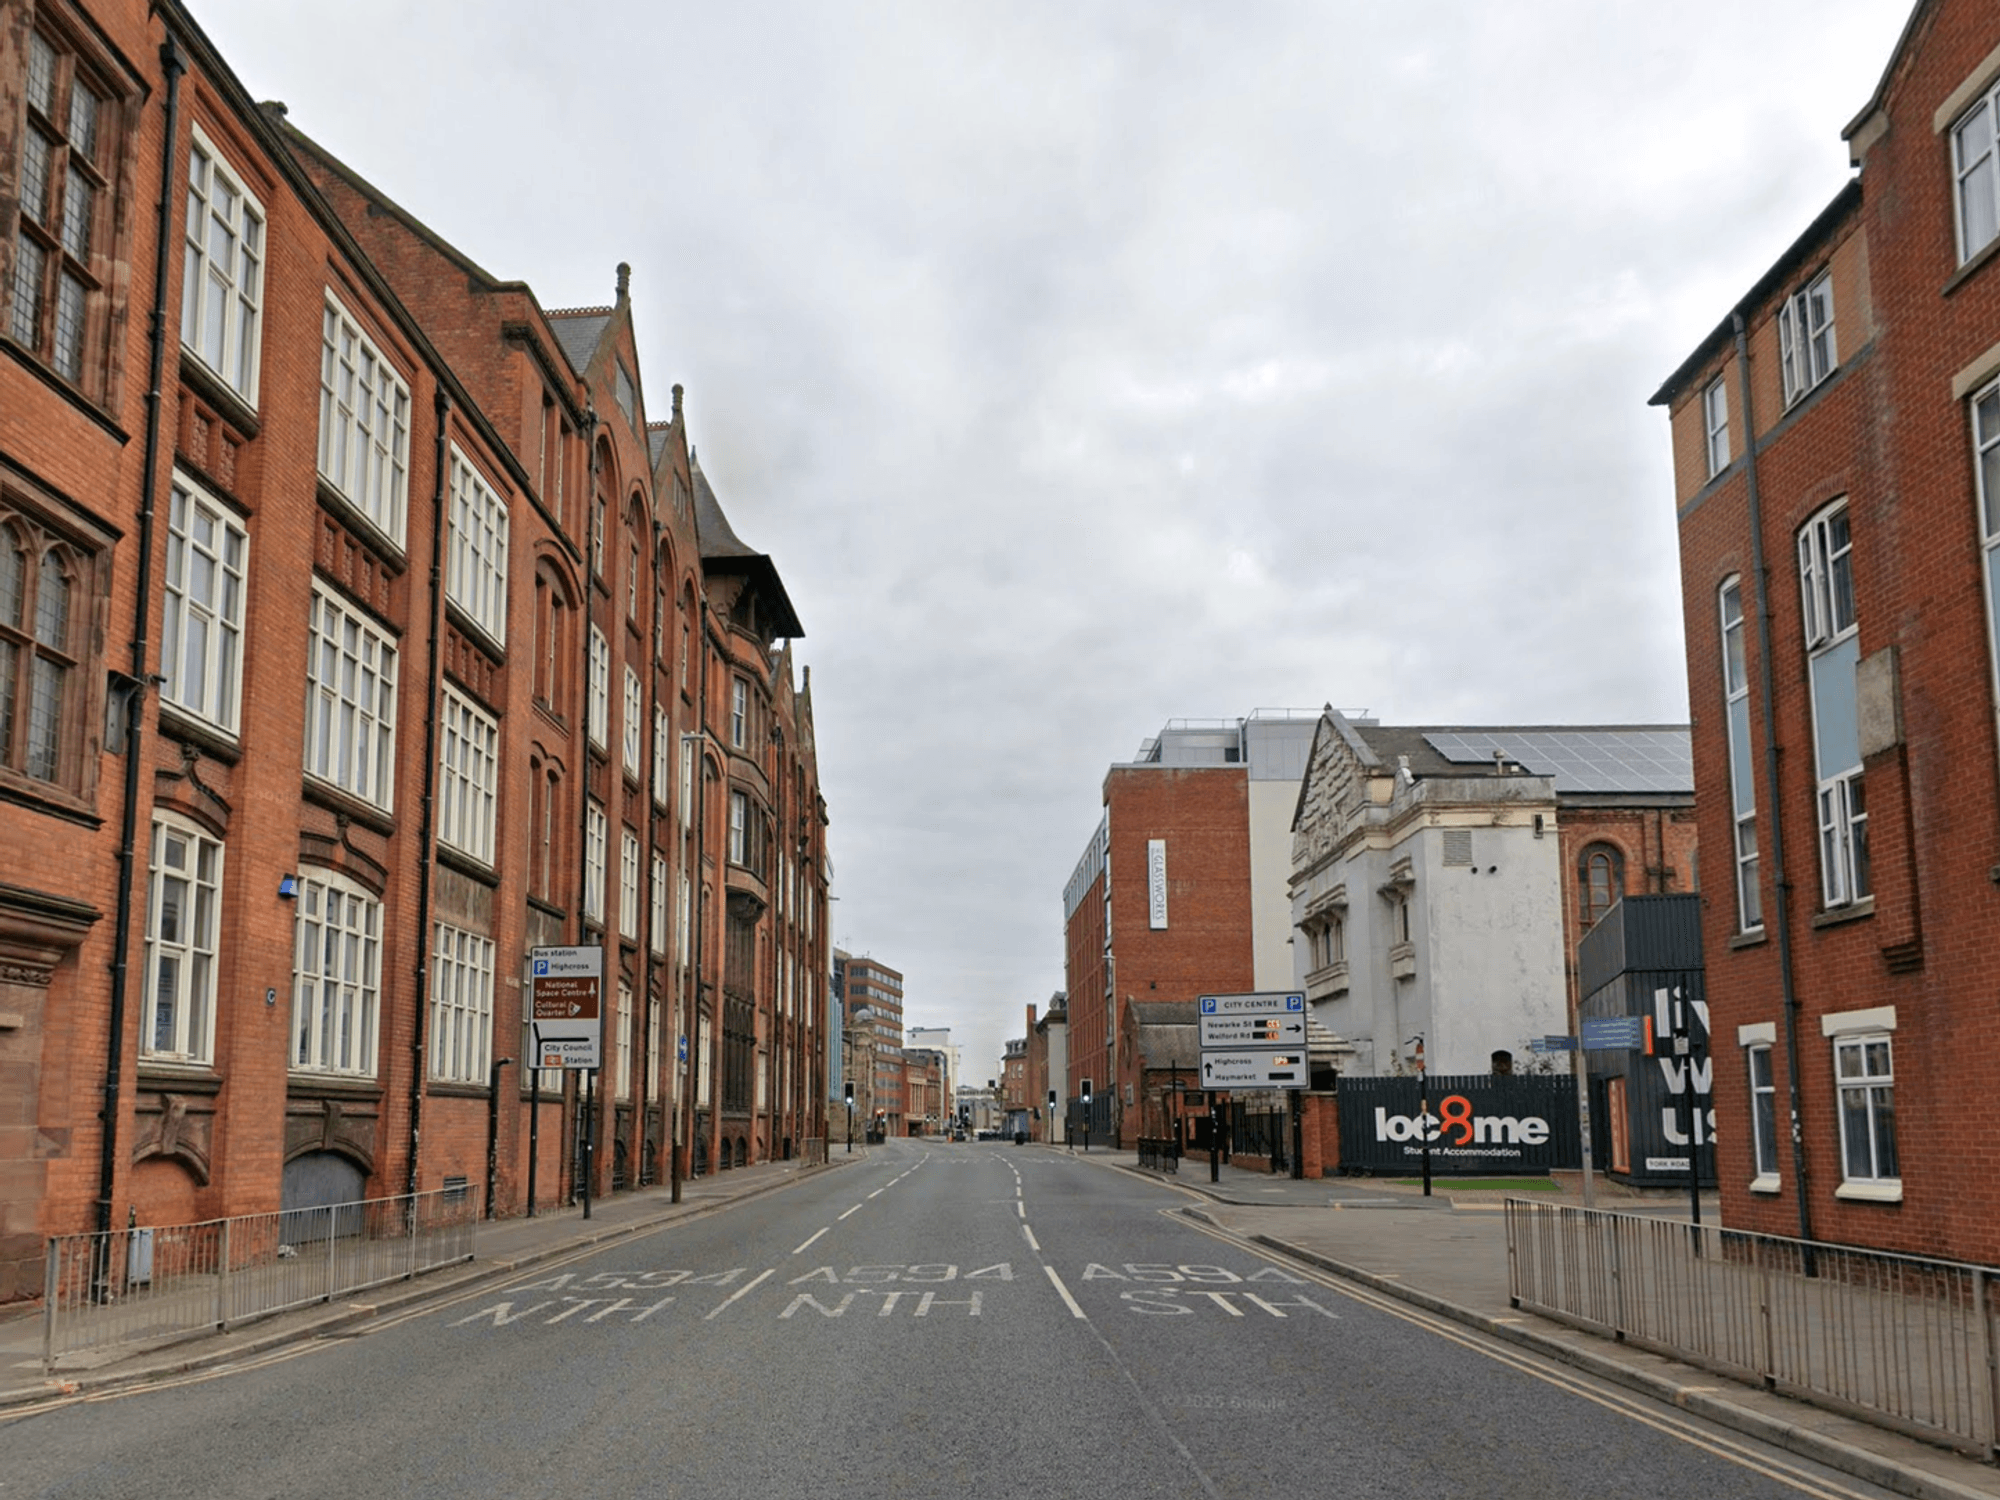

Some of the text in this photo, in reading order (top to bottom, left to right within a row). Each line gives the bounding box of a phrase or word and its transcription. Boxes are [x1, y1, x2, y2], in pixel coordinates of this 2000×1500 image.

[550, 949, 577, 957] station
[551, 963, 589, 971] Highcross
[536, 989, 559, 997] Space
[1224, 1001, 1242, 1009] CITY
[1245, 1000, 1278, 1008] CENTRE
[1243, 1020, 1252, 1028] St
[544, 1044, 560, 1052] City
[564, 1056, 593, 1064] Station
[1214, 1058, 1252, 1066] Highcross
[1215, 1073, 1256, 1081] Haymarket
[1443, 1147, 1521, 1157] Accommodation
[1649, 1160, 1668, 1168] YORK
[788, 1263, 1019, 1285] A594
[1081, 1263, 1310, 1285] A594
[502, 1268, 747, 1294] A594
